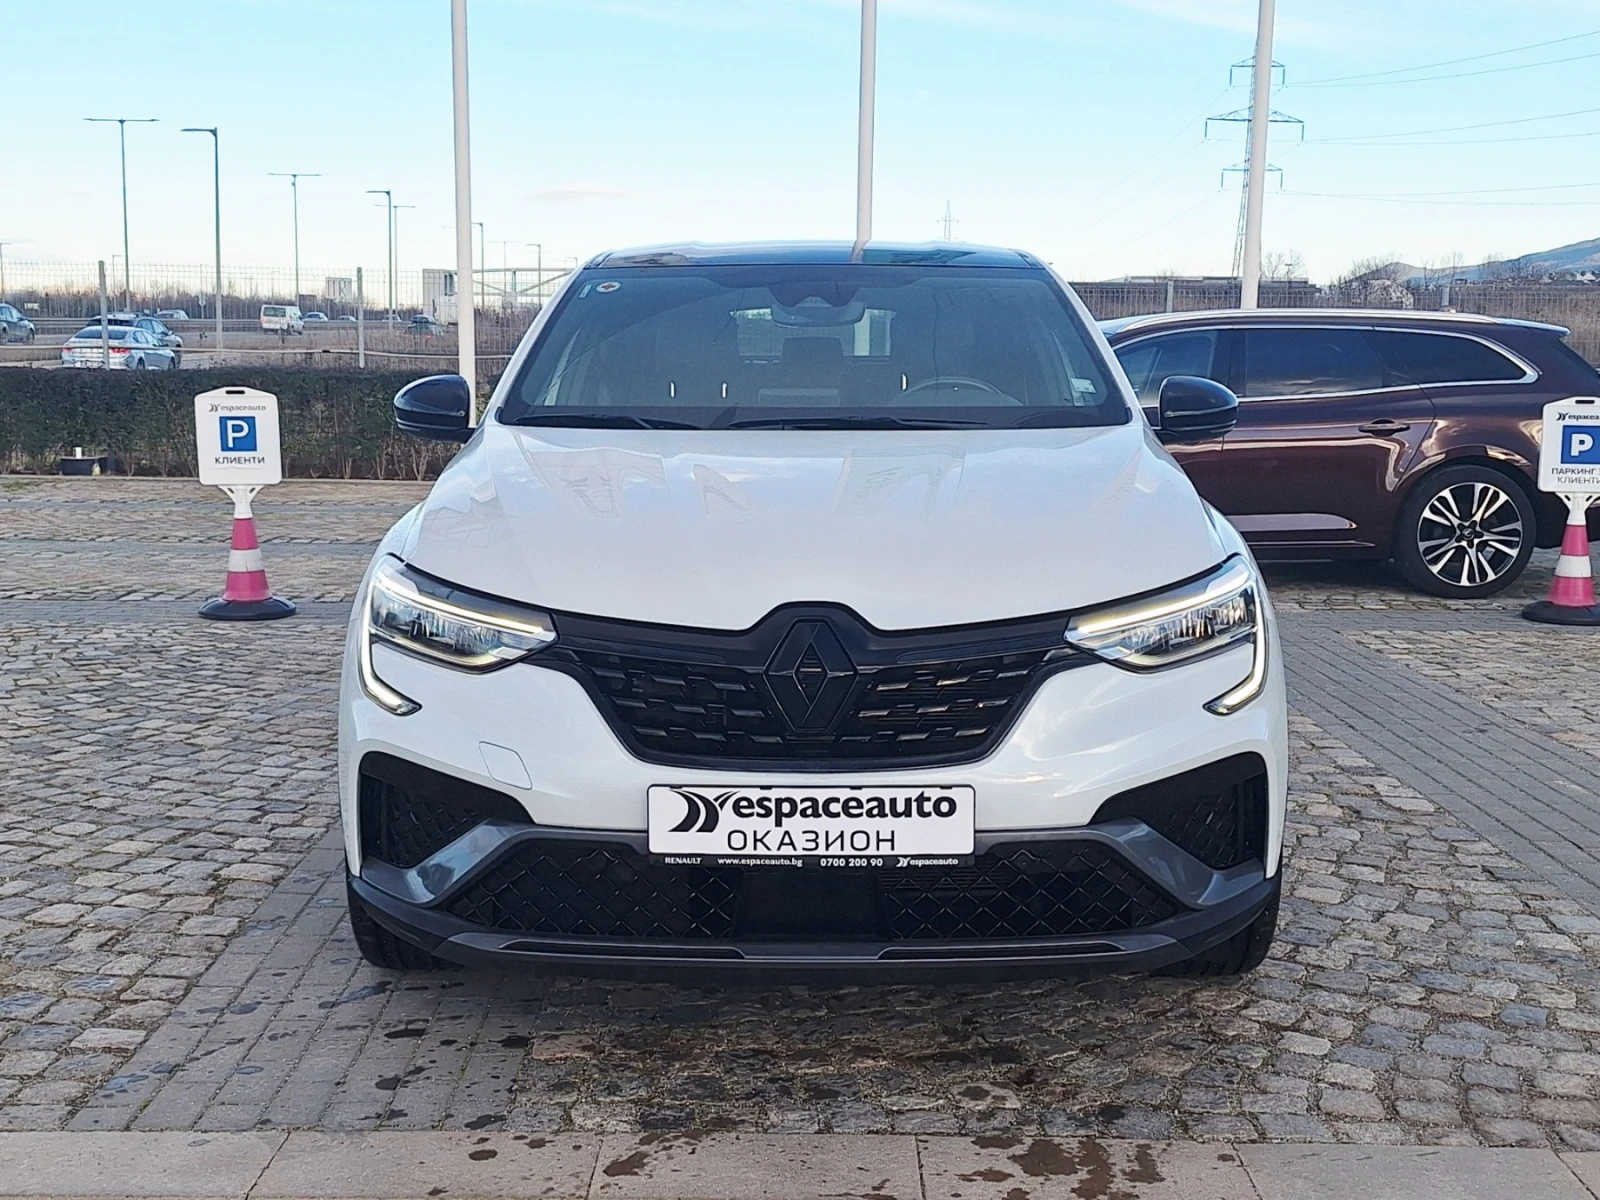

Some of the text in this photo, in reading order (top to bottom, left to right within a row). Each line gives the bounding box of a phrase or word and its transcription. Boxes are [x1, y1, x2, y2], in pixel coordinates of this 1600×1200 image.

[226, 420, 249, 448] P
[1570, 433, 1594, 457] P
[214, 456, 266, 465] КЛИЕНТИ
[1551, 467, 1597, 475] ПАРКИНГ
[732, 790, 957, 828] espaceauto
[727, 829, 896, 852] ОКАЗИОН
[664, 857, 959, 867] RENAULT www.espaceauto.bg 0700 200 90 espaceauto
